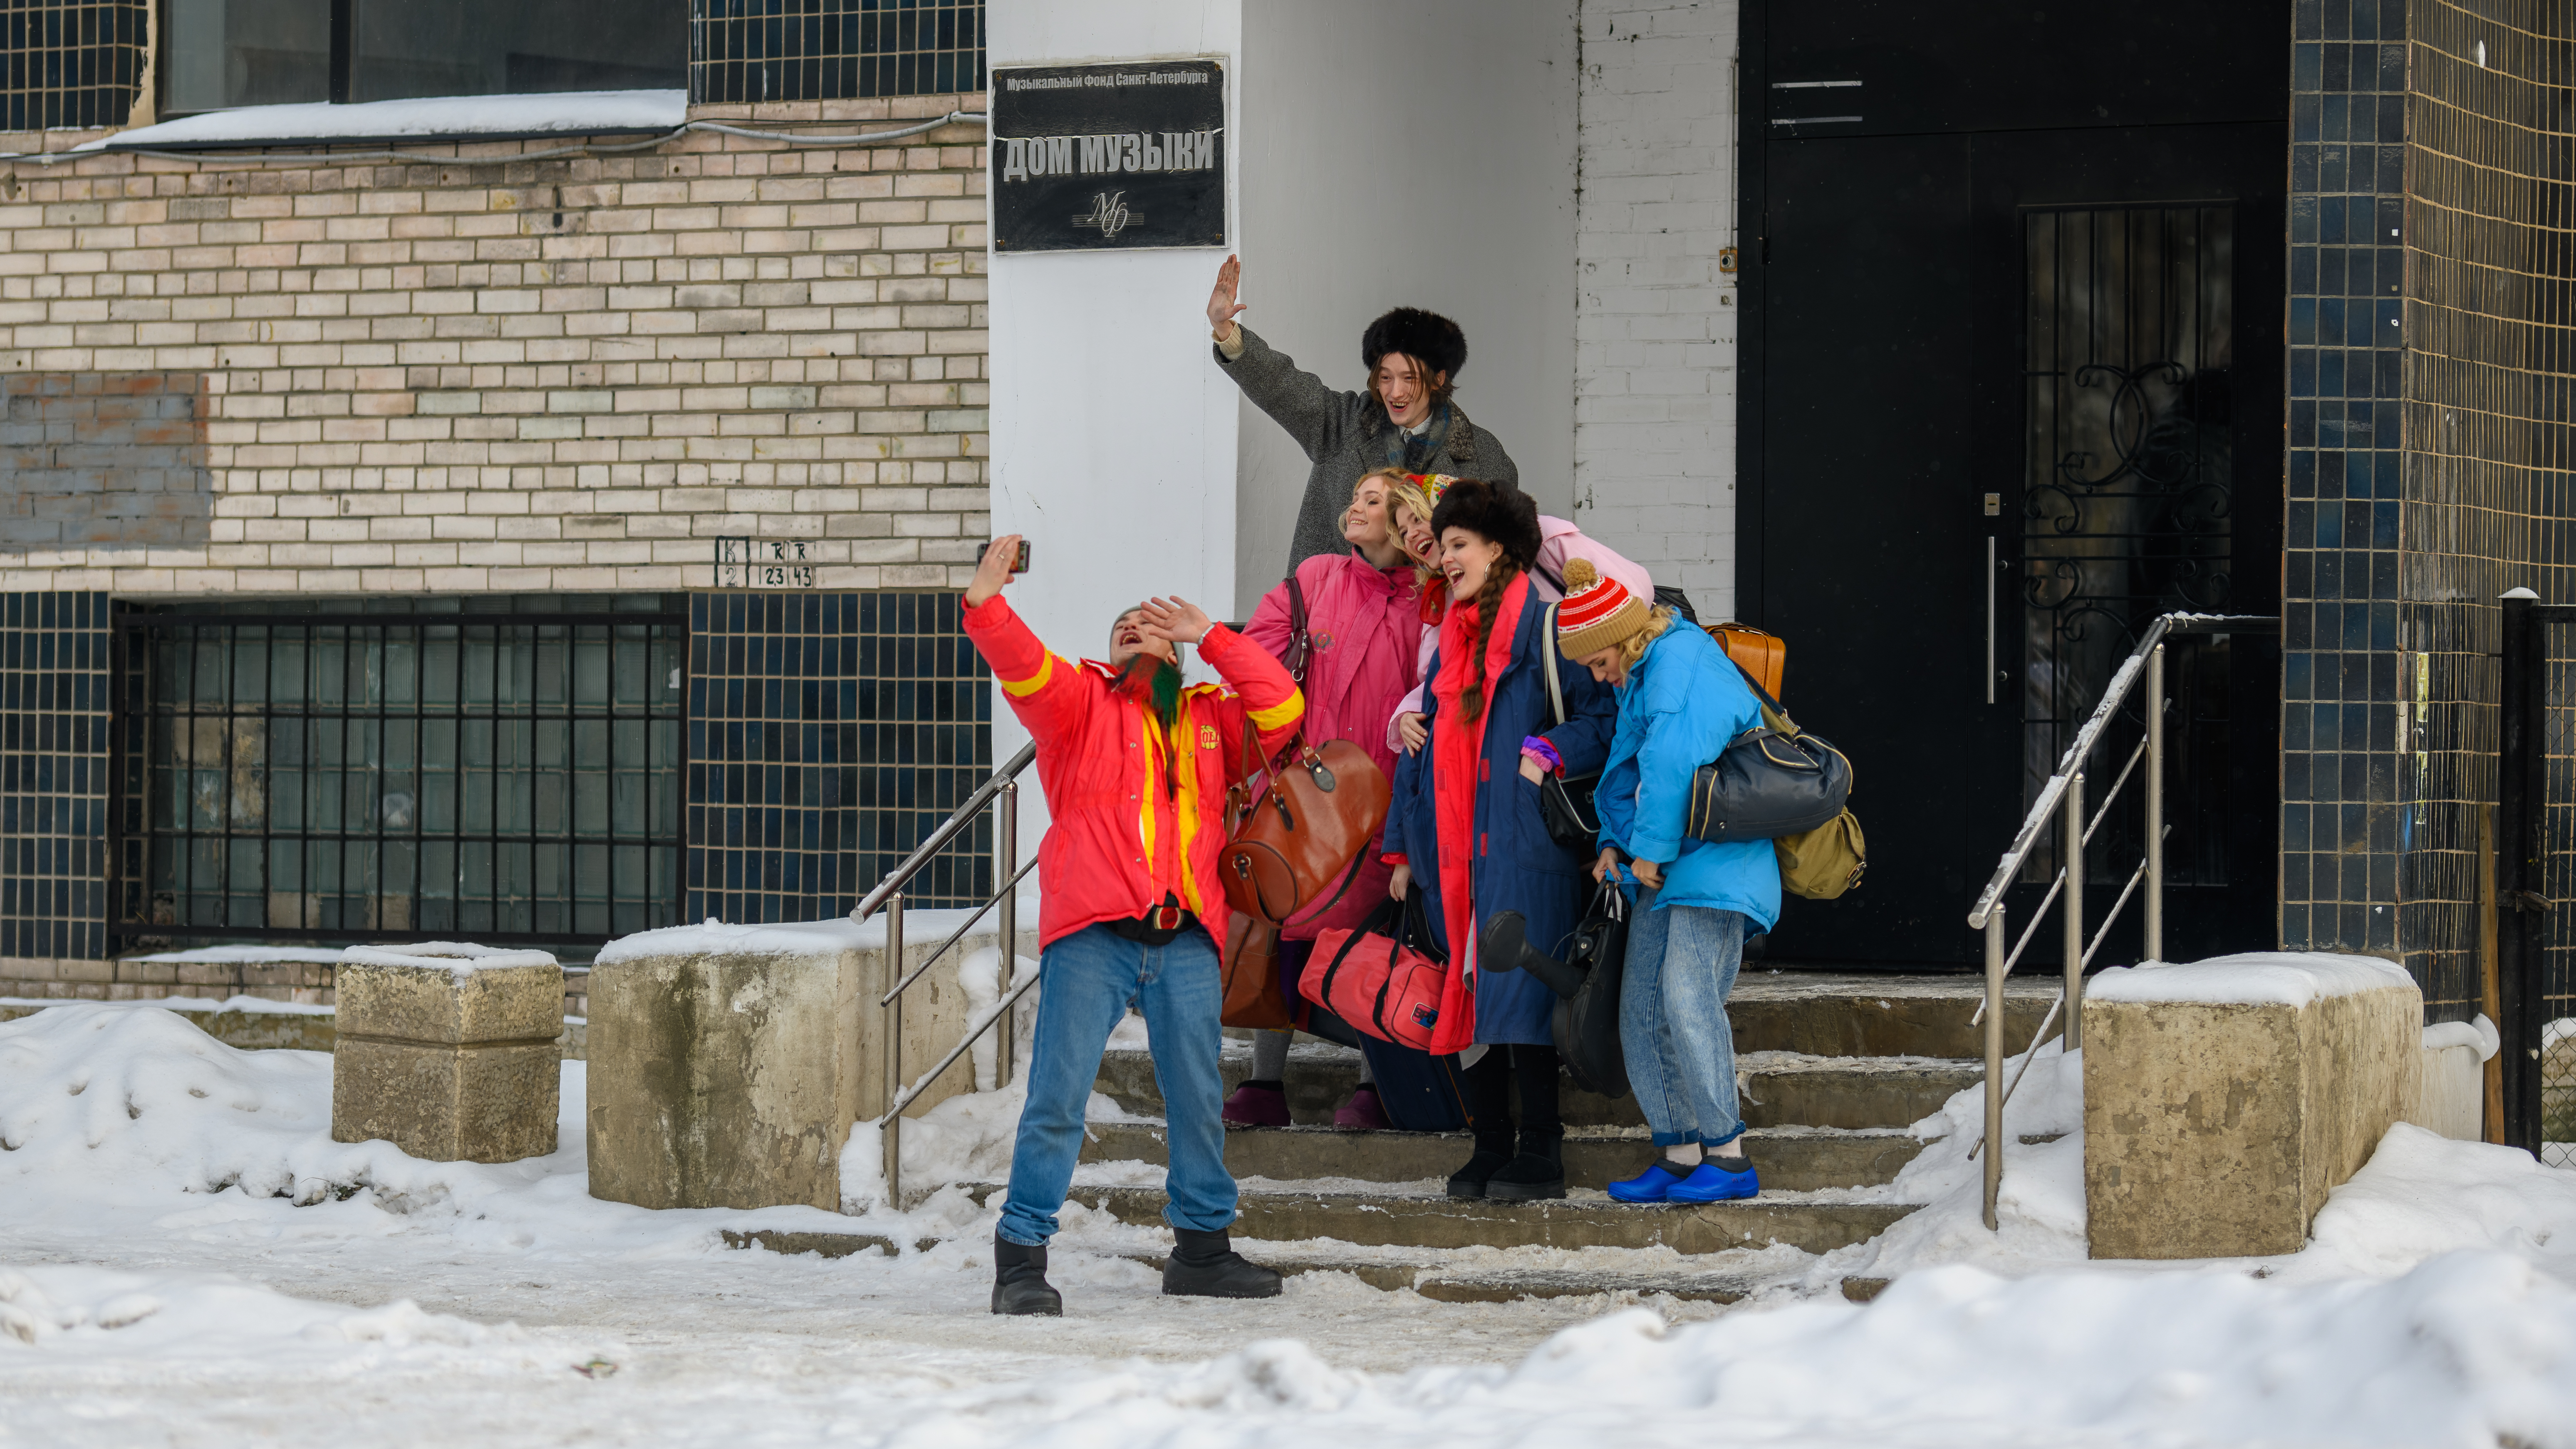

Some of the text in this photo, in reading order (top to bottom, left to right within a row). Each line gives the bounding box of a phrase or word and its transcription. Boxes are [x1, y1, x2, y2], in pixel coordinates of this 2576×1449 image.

[1007, 71, 1208, 91] Музыкальный Фонд Санкт-Петербурга
[1003, 132, 1214, 182] ДОМ МУЗЫКИ
[725, 565, 738, 587] 2
